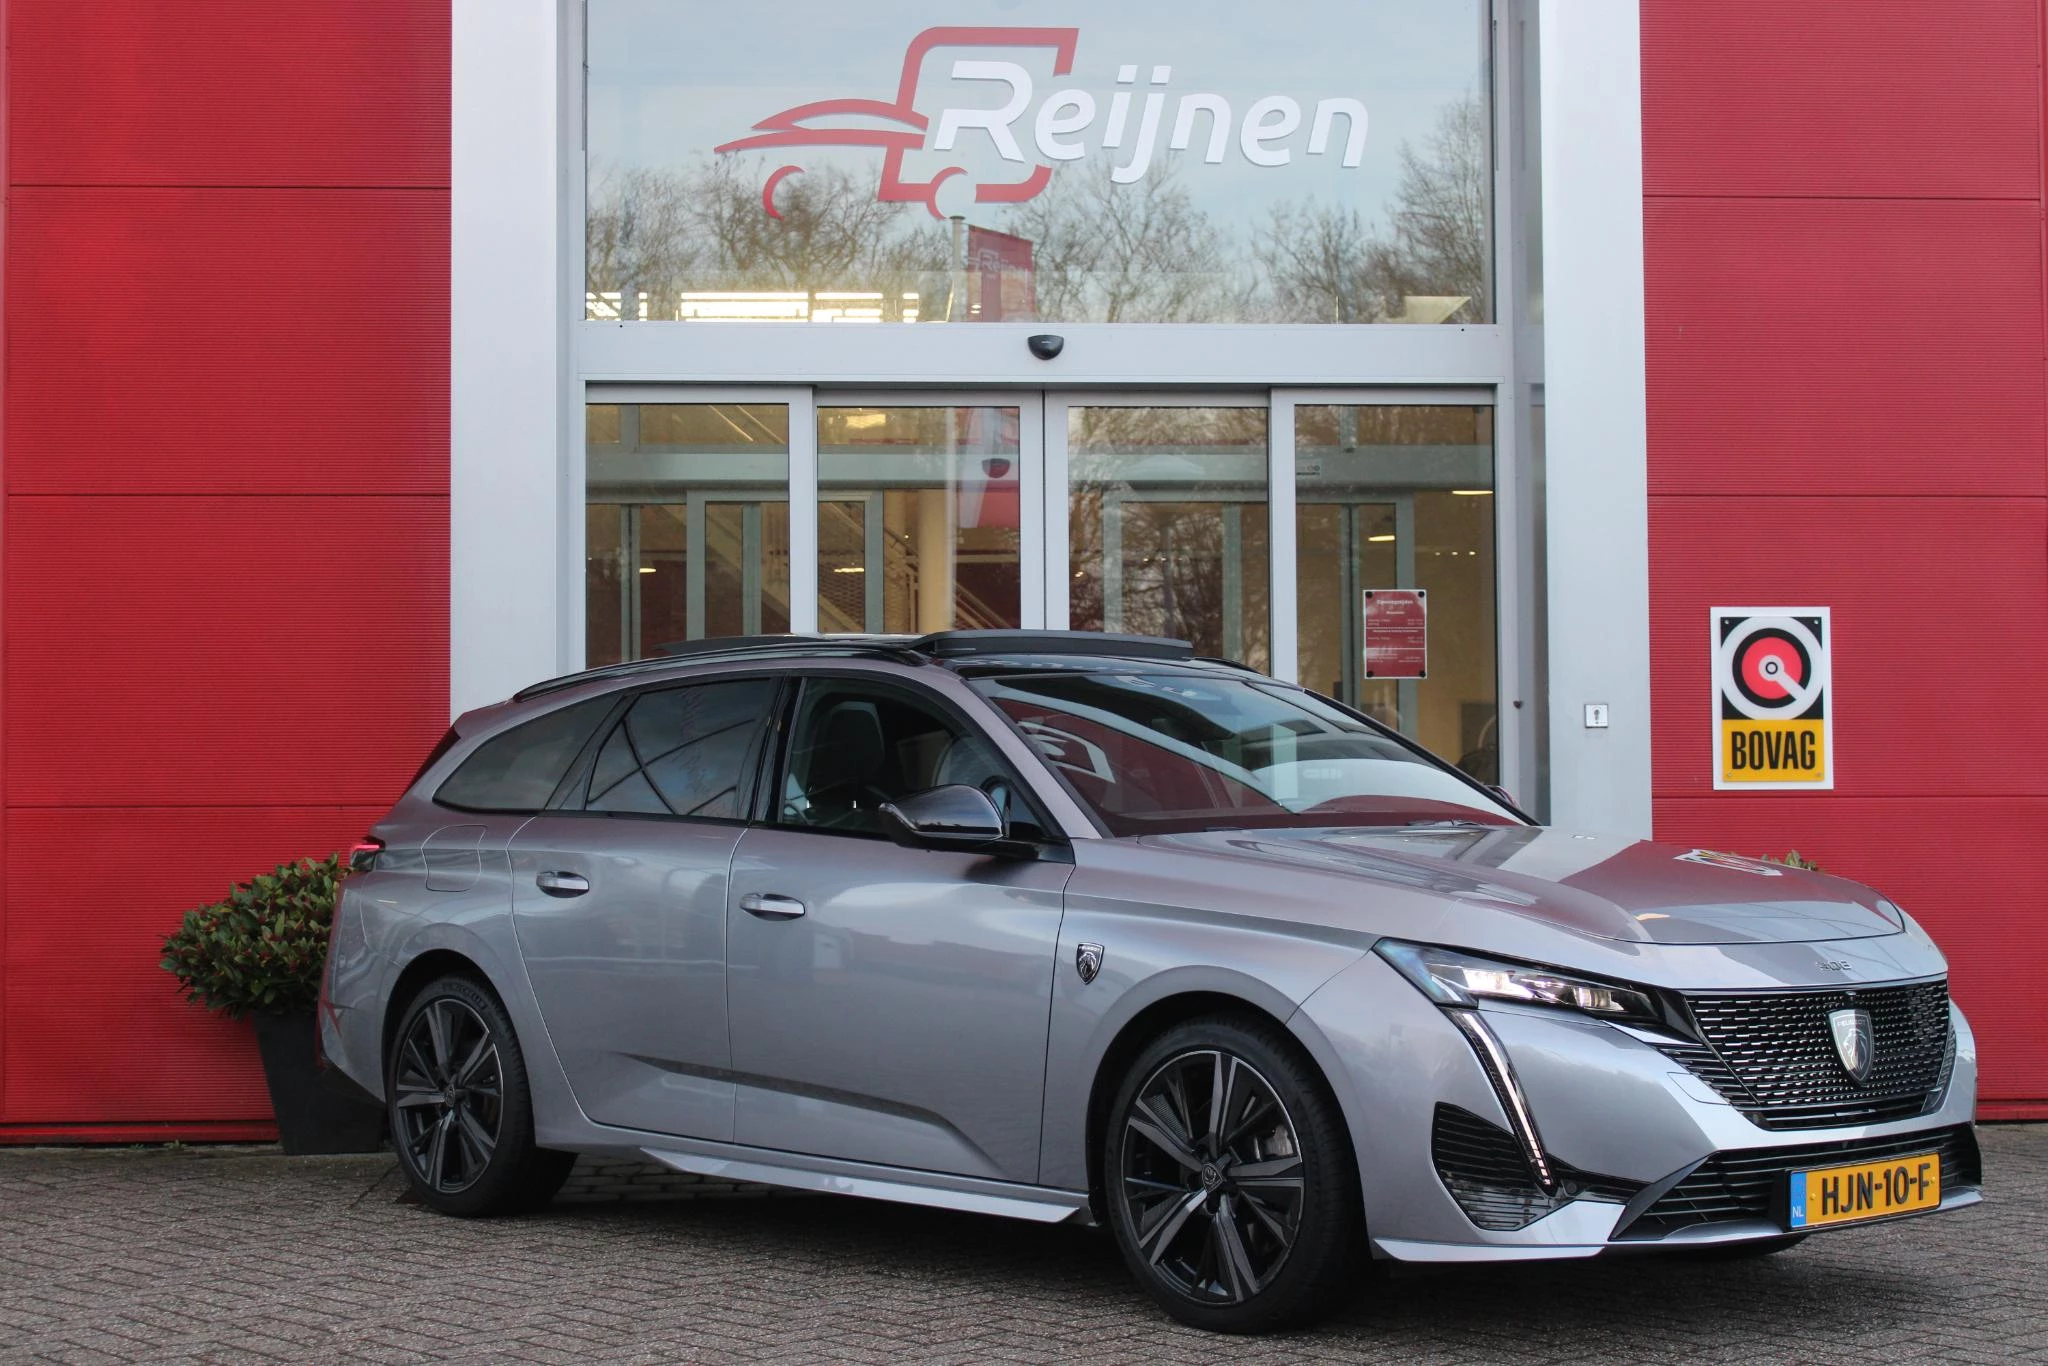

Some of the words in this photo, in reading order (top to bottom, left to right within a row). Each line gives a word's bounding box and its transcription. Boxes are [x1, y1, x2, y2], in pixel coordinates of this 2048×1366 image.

[934, 61, 1369, 184] Reijnen
[1731, 730, 1816, 770] BOVAG
[1792, 1206, 1804, 1218] NL
[1822, 1163, 1931, 1215] HJN-10-F
